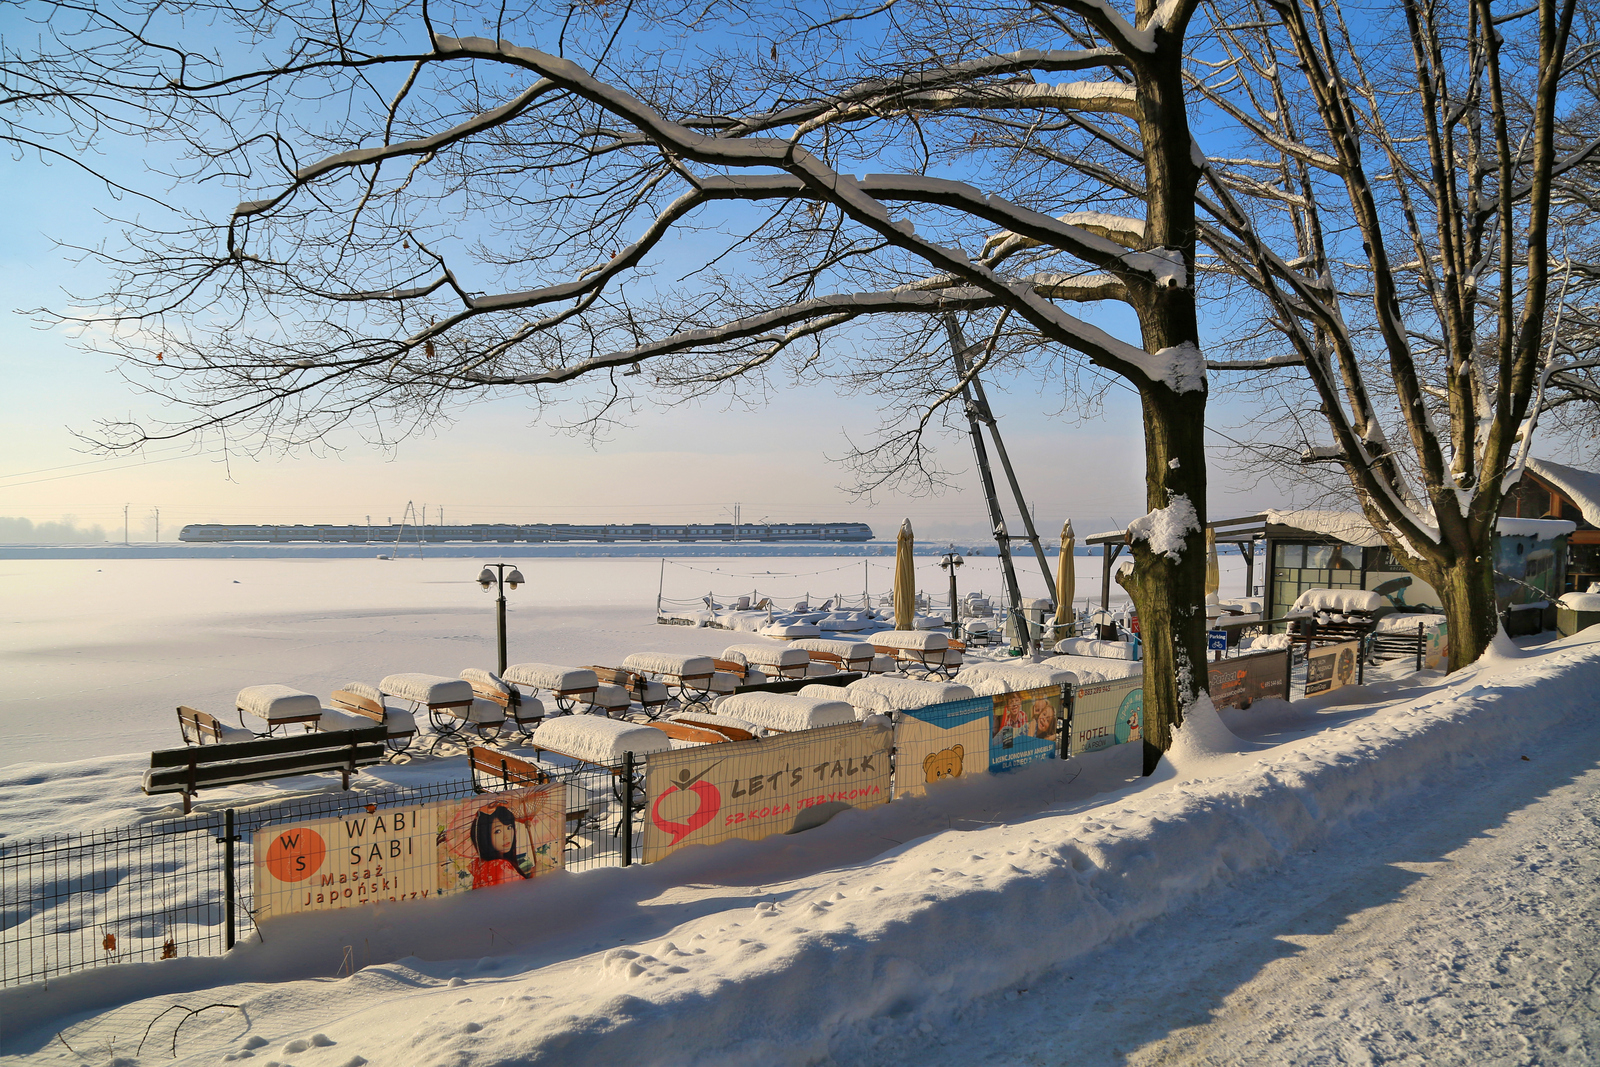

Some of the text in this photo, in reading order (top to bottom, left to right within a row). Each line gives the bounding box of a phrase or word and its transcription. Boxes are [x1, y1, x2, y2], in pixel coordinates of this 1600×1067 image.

[1209, 633, 1226, 641] Parking
[1079, 726, 1109, 742] HOTEL
[731, 754, 876, 799] LET'S TALK
[345, 810, 417, 839] WABI
[725, 803, 791, 827] SZKOŁA
[280, 833, 300, 850] W
[350, 836, 414, 866] SABI
[295, 855, 306, 872] S
[321, 865, 383, 888] Masaż
[305, 876, 398, 906] Japoński
